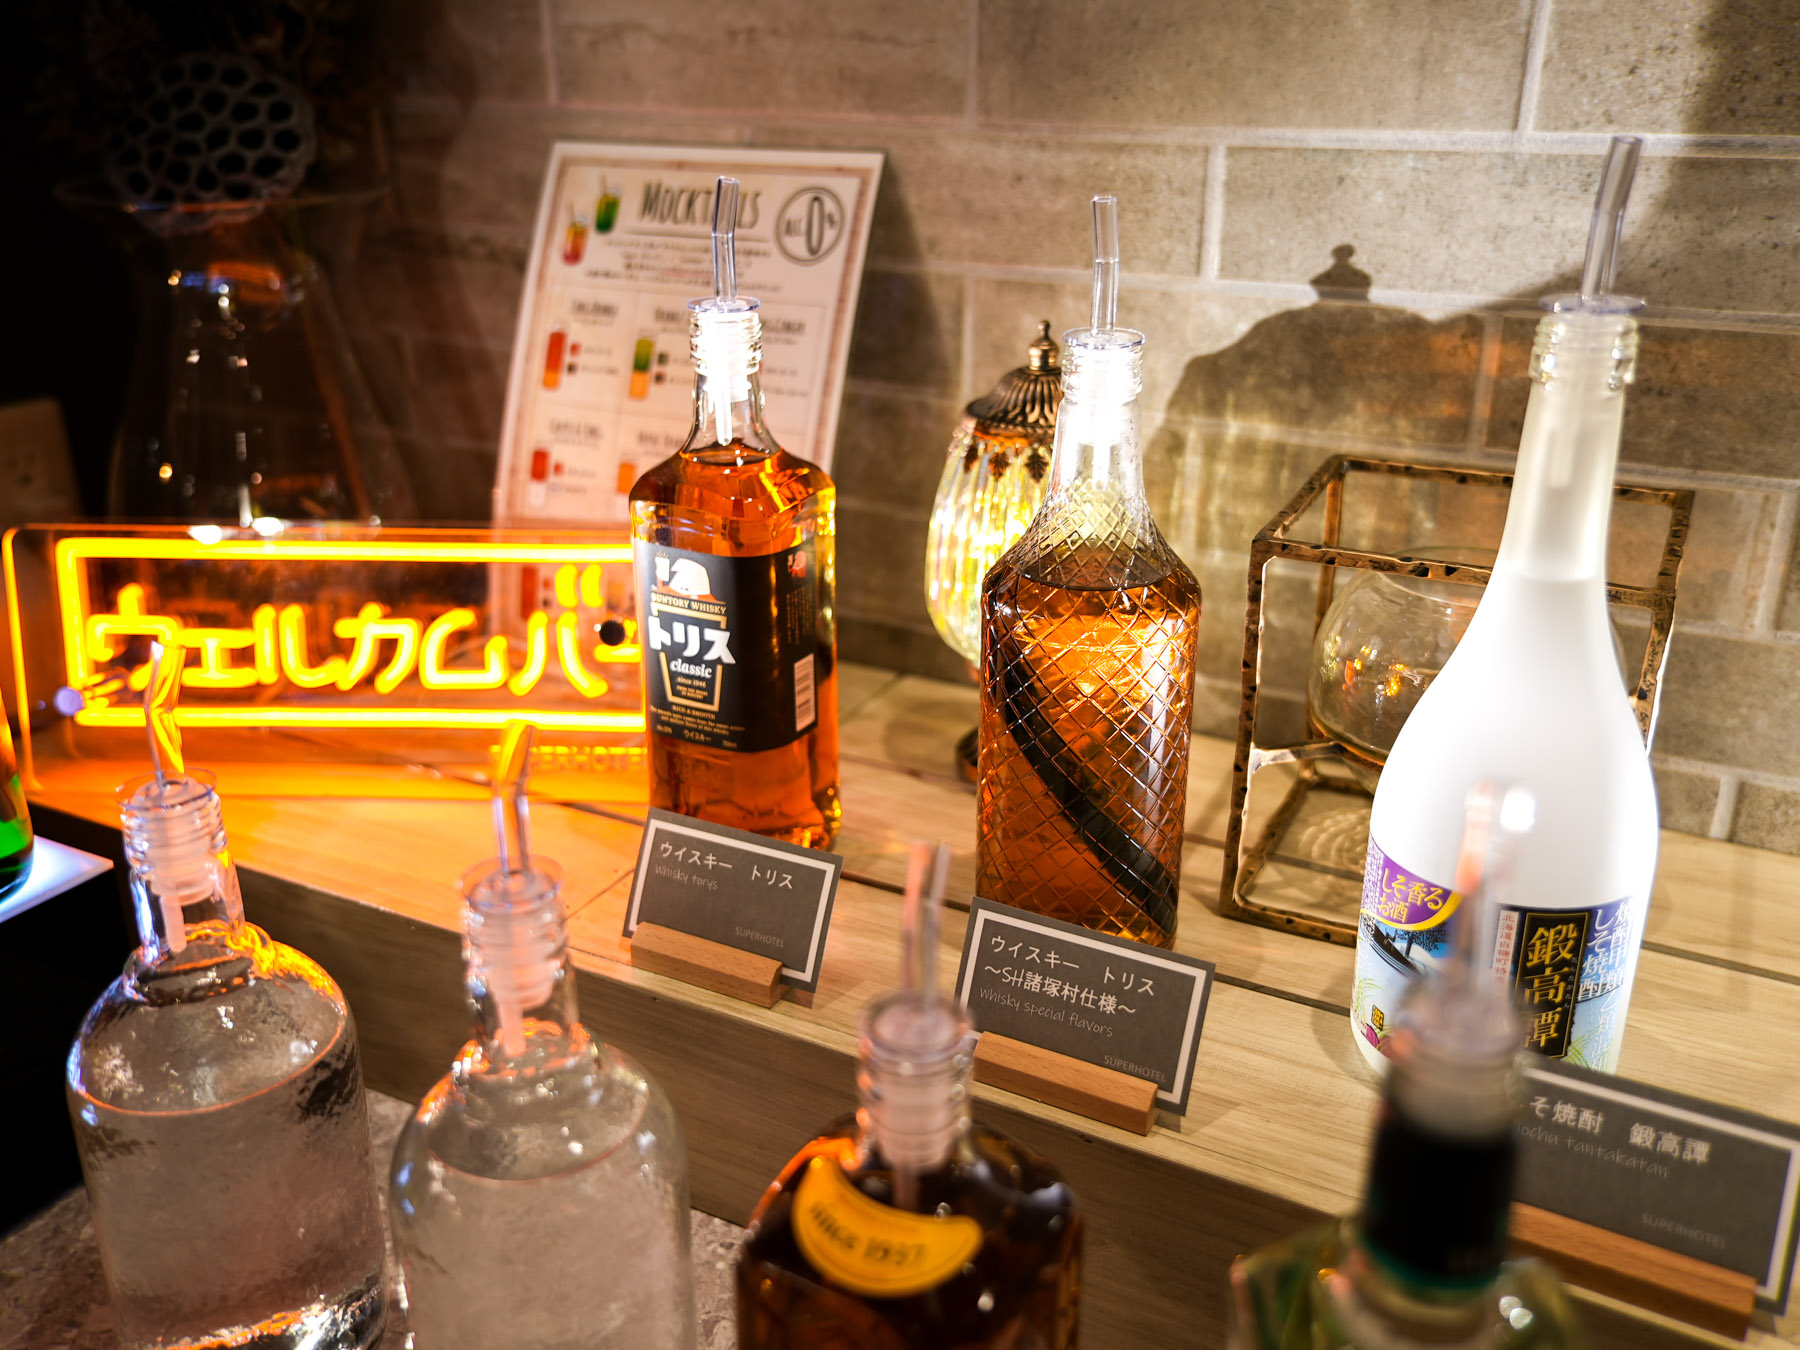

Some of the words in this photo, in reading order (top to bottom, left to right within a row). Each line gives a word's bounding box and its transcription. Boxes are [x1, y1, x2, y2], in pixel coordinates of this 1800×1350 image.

[640, 180, 761, 229] MOCKTLS
[650, 592, 690, 608] SUNTORY
[691, 600, 727, 615] WHISKY
[648, 615, 736, 664] トリス
[670, 658, 713, 679] classic
[661, 841, 733, 870] ウイスキー
[752, 864, 793, 890] トリス
[692, 873, 718, 891] torys
[1381, 867, 1443, 911] しそ香る
[1378, 898, 1408, 923] お酒
[735, 926, 785, 948] SUPERHOTEL
[1577, 909, 1612, 1001] しそ焼酎
[991, 935, 1080, 969] ウイスキー
[1103, 965, 1154, 996] トリス
[1024, 1000, 1064, 1023] special
[1069, 1013, 1113, 1038] flavors
[1103, 1054, 1166, 1083] SUPERHOTEL
[1522, 1095, 1604, 1135] そ焼酎
[1566, 1134, 1668, 1179] tantakatan
[1641, 1212, 1728, 1250] SUPERHOTEL
